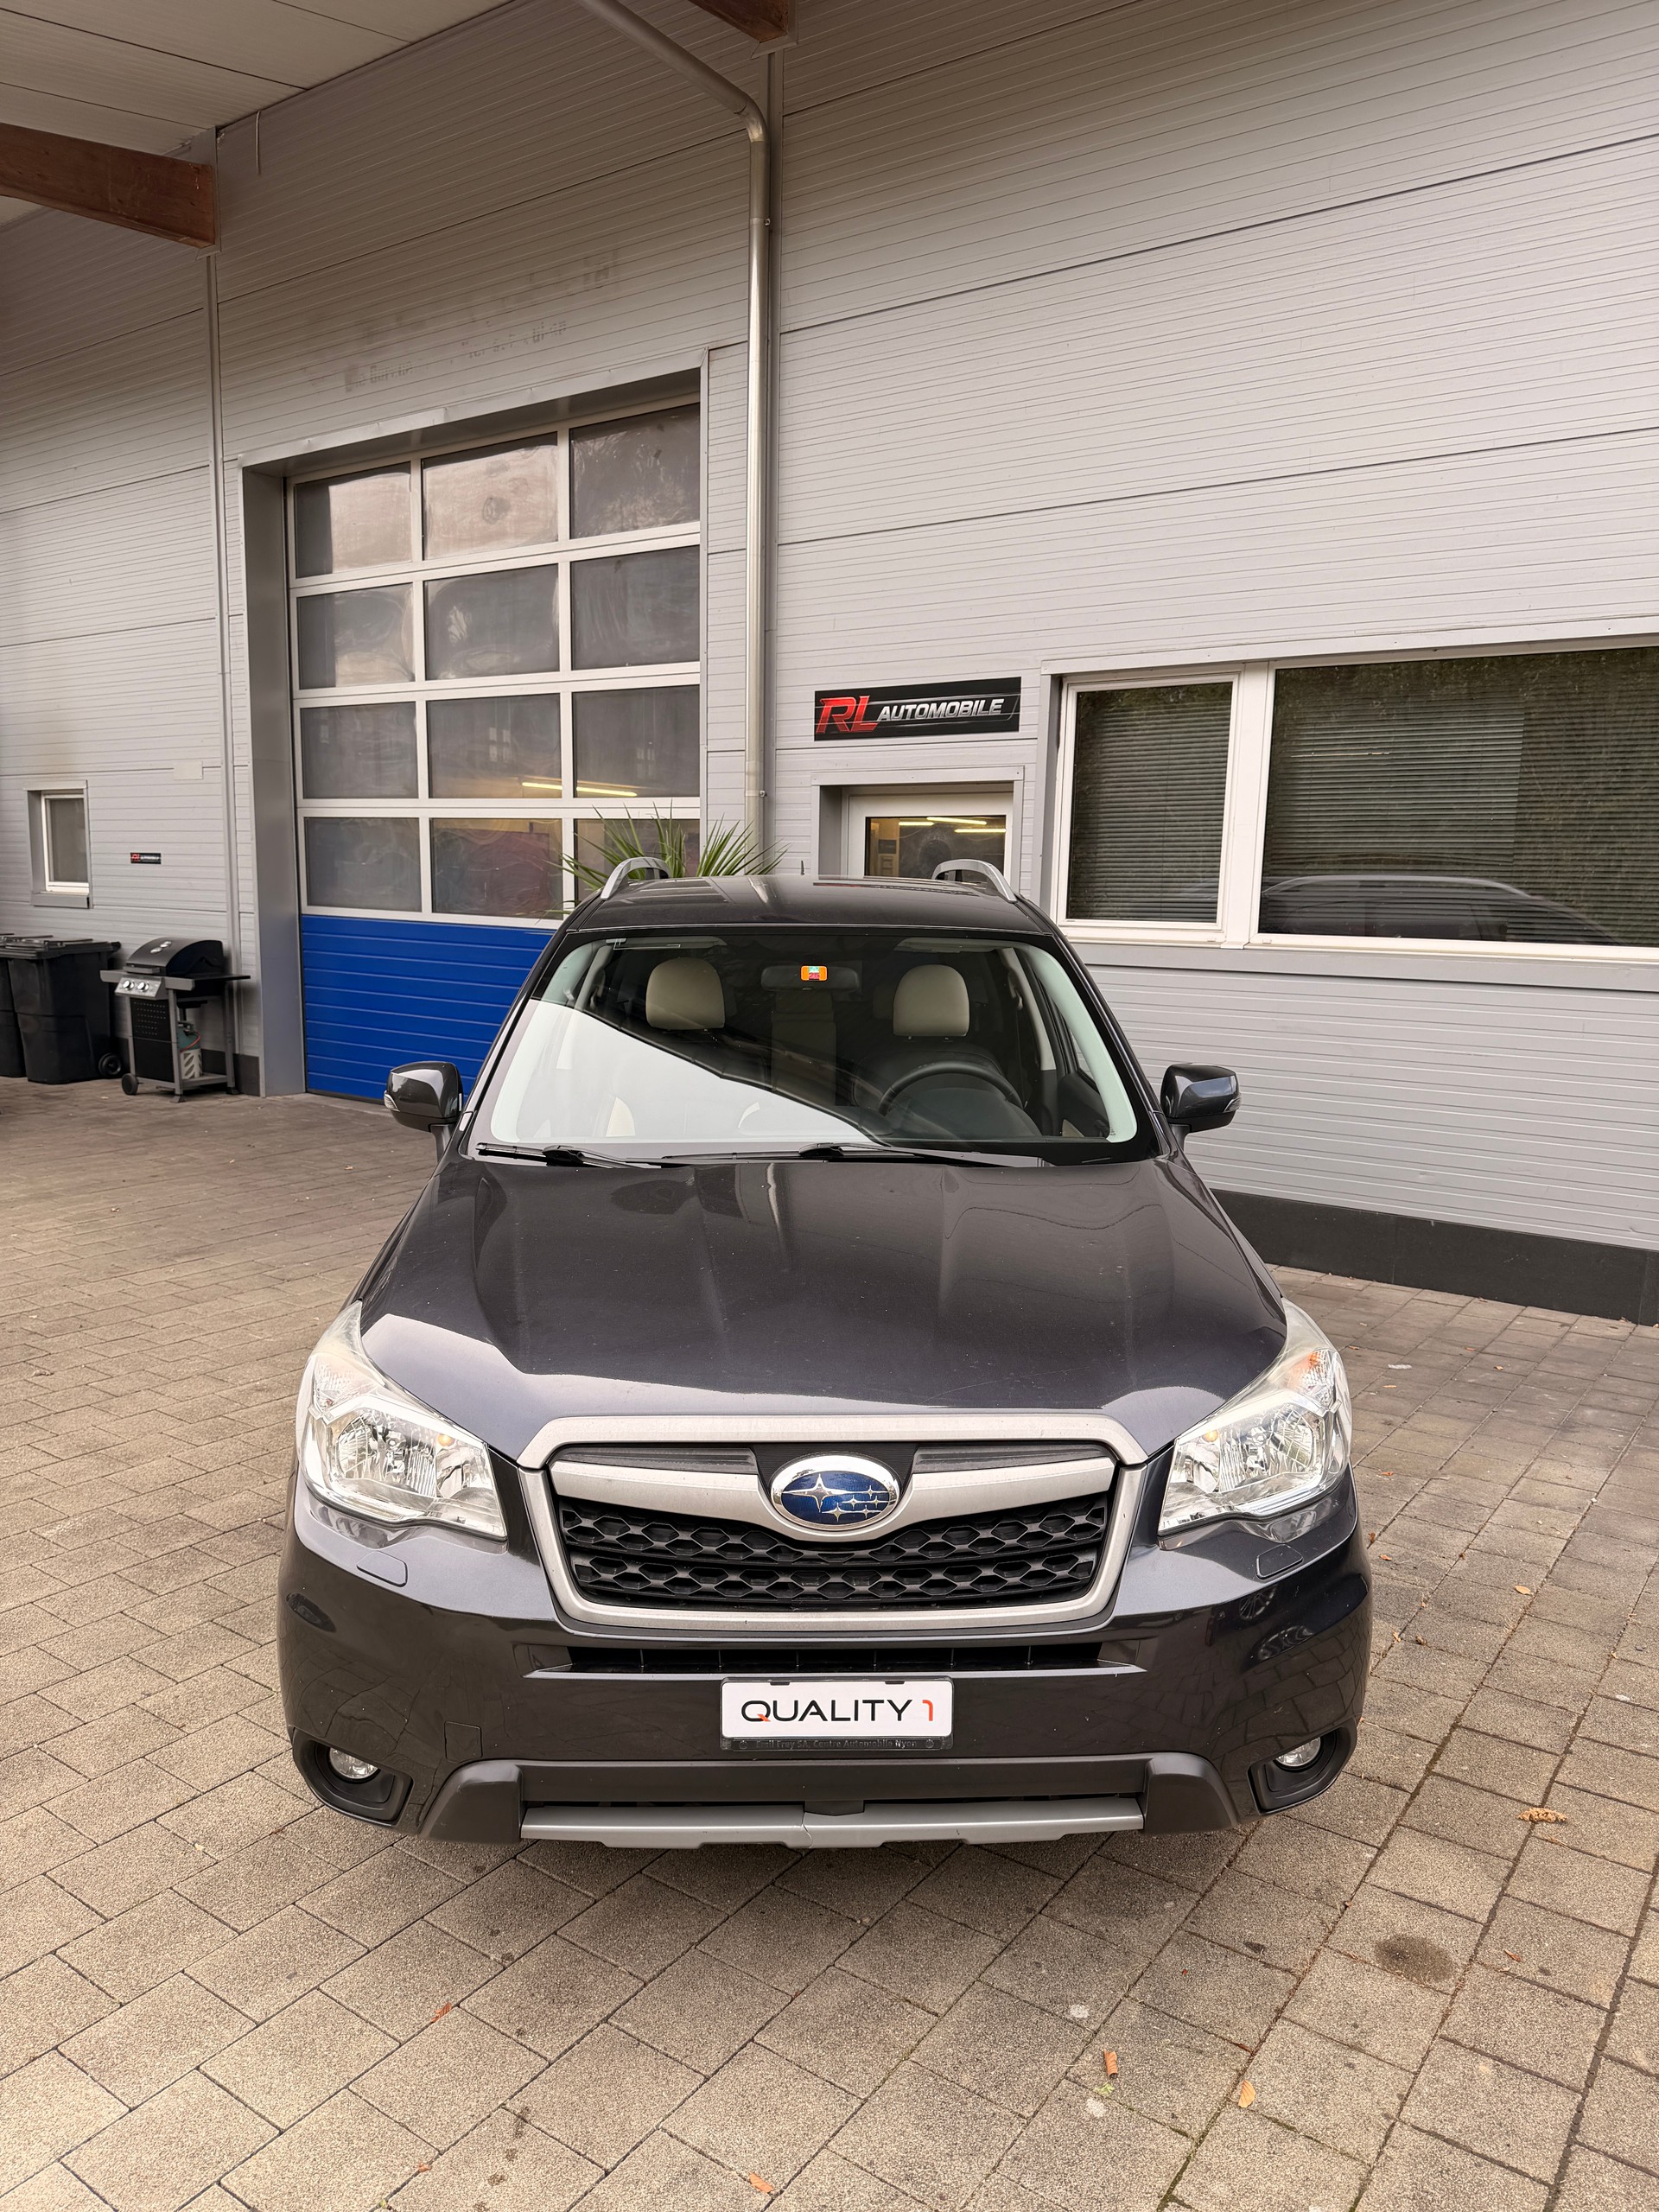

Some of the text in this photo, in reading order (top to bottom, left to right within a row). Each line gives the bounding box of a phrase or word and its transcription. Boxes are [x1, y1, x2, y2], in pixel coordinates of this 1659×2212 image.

[816, 695, 1005, 734] RL AUTOMOBILE
[741, 1699, 934, 1722] QUALITY 1
[894, 1738, 917, 1750] Nyon
